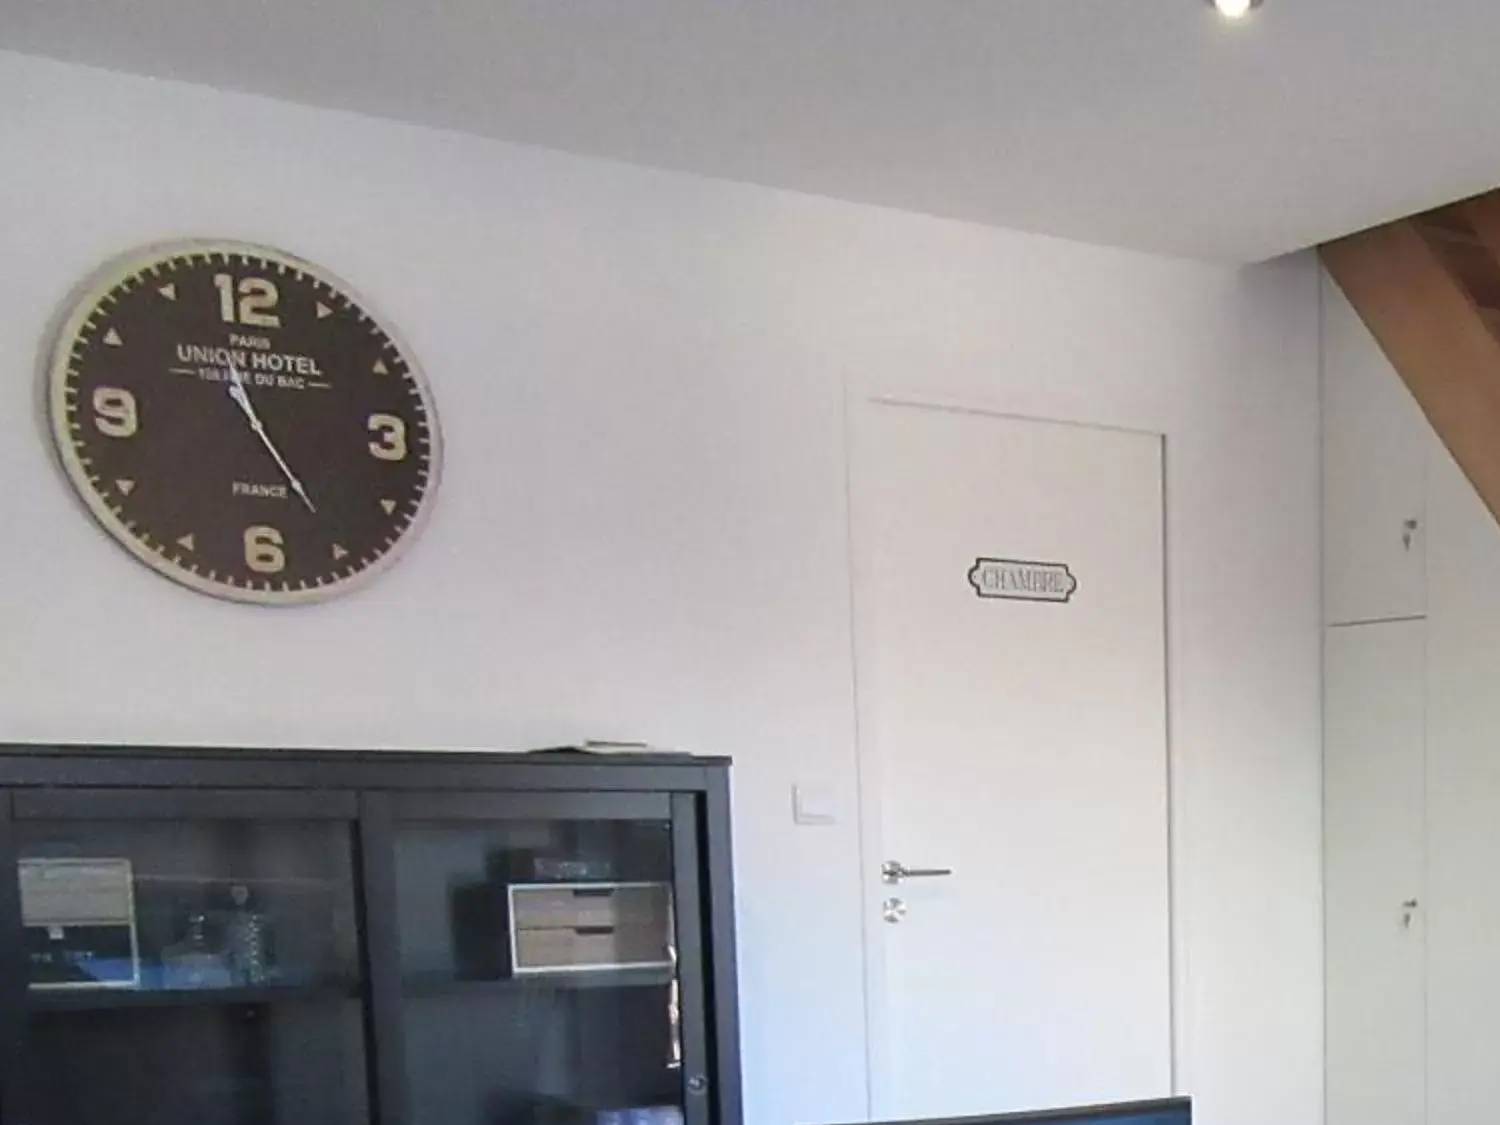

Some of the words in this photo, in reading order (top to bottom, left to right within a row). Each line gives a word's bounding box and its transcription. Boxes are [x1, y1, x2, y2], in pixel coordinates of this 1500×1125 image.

[214, 273, 280, 327] 12
[177, 344, 247, 367] UNION
[252, 351, 322, 376] HOTEL
[92, 387, 138, 438] 9
[367, 413, 408, 461] 3
[232, 481, 288, 499] FRANCE
[243, 525, 286, 573] 6
